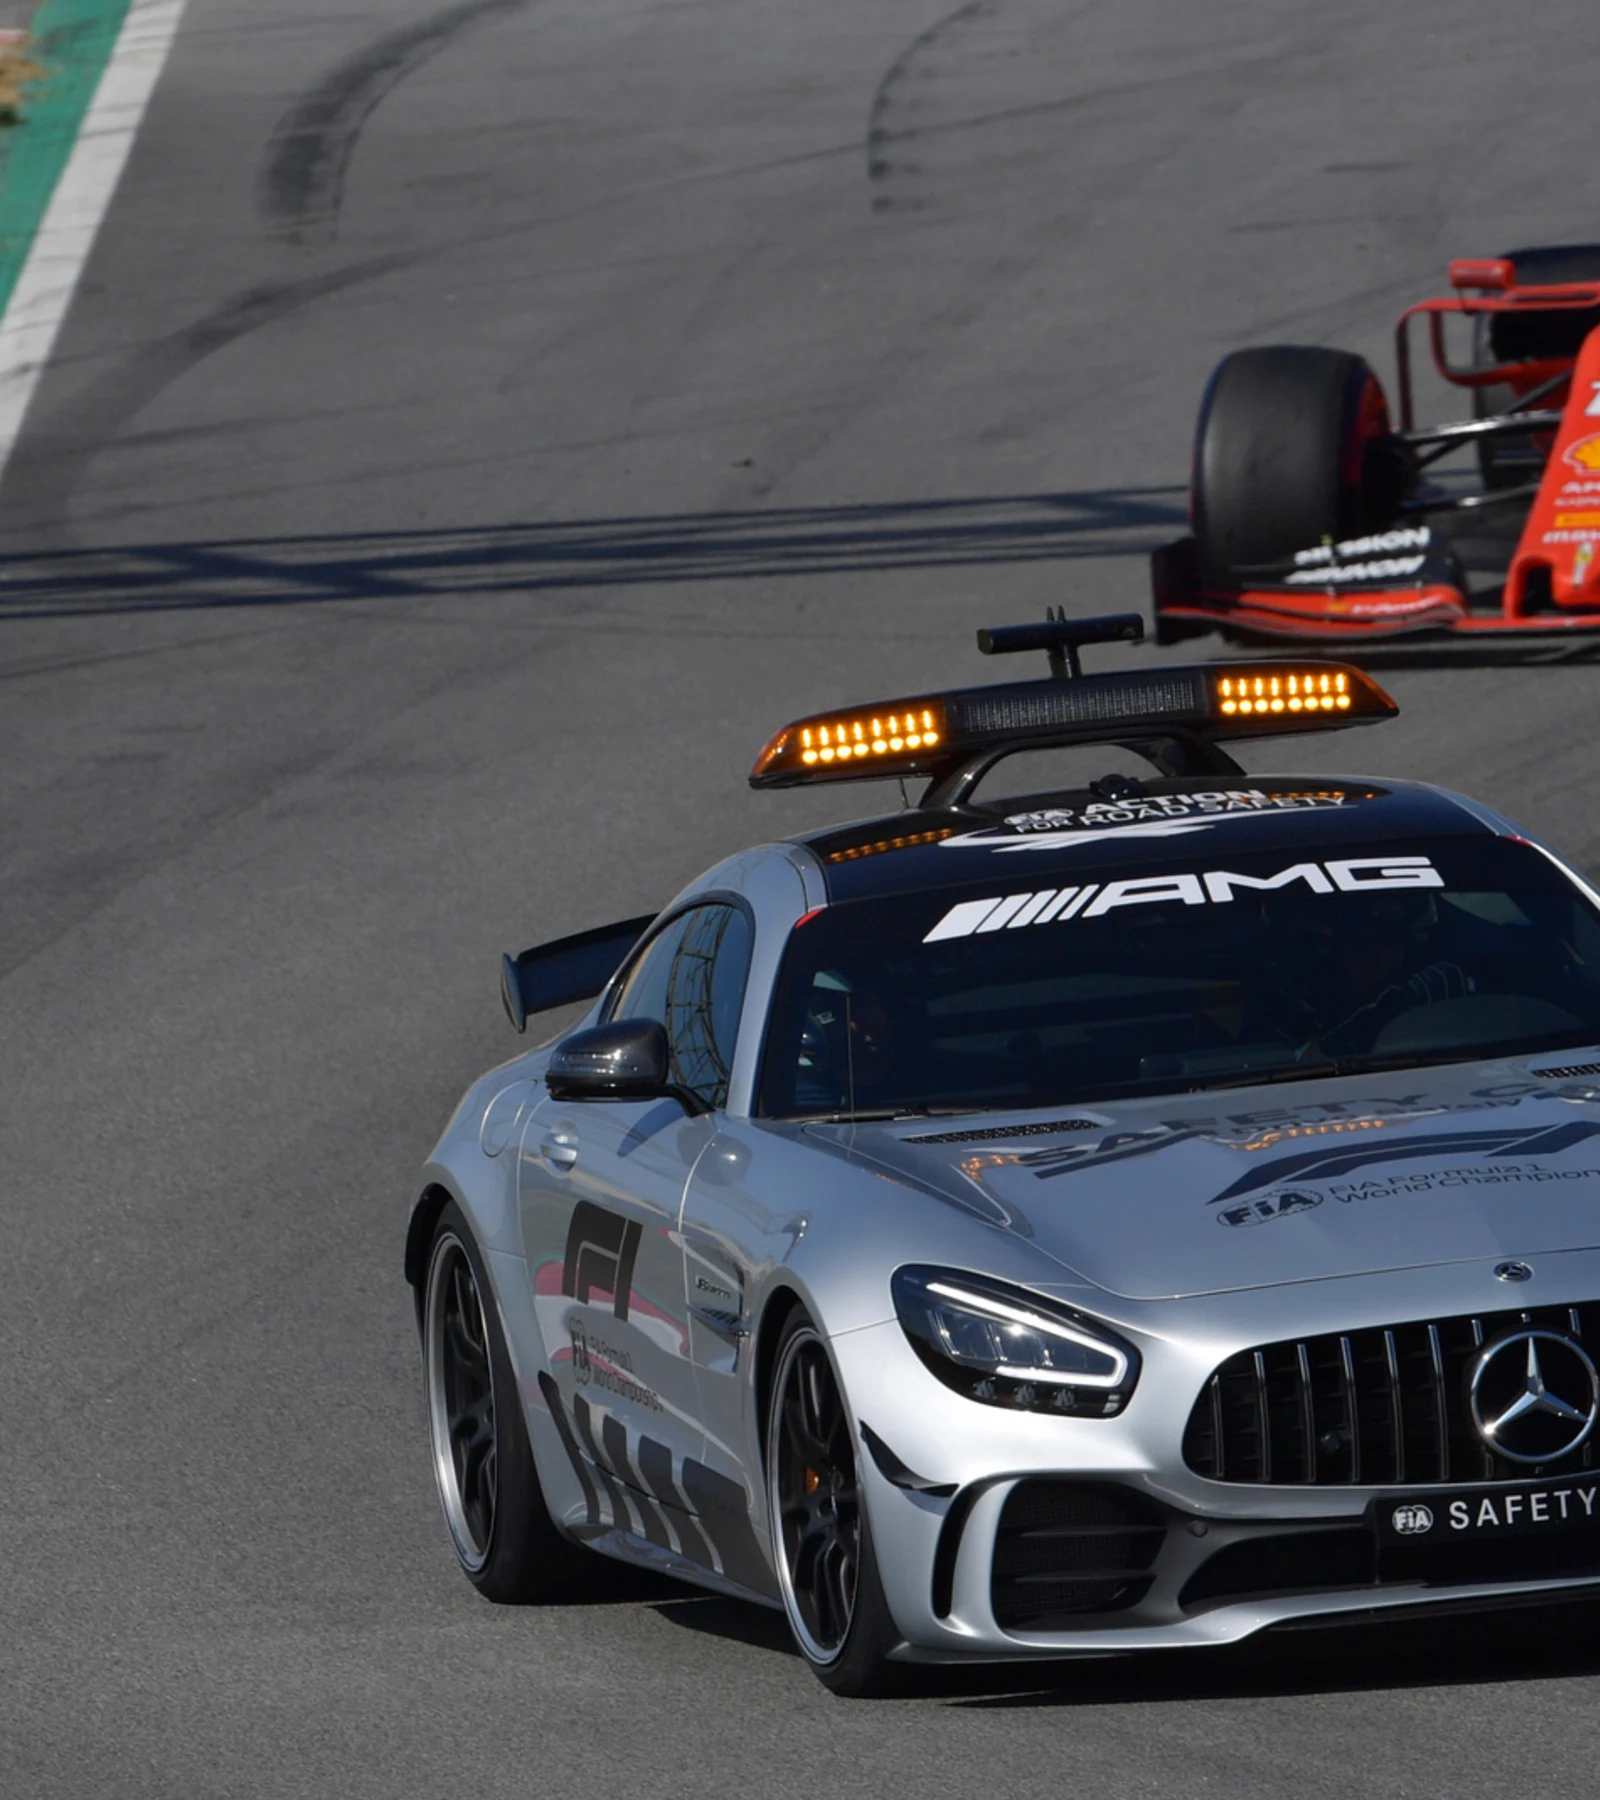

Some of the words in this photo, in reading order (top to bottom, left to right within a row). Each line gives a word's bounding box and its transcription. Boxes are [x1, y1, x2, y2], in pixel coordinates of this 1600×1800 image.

[1015, 818, 1072, 833] FOR
[1079, 803, 1191, 827] ROAD
[1199, 795, 1346, 813] SAFETY
[1085, 789, 1267, 814] ACTION
[1083, 857, 1445, 918] AMG
[1329, 1181, 1383, 1195] FIA
[1387, 1163, 1523, 1186] Formula
[1525, 1163, 1548, 1172] 1
[1335, 1178, 1432, 1204] World
[1221, 1189, 1318, 1226] FIA
[1394, 1508, 1432, 1530] FIA
[1449, 1486, 1597, 1530] SAFETY
